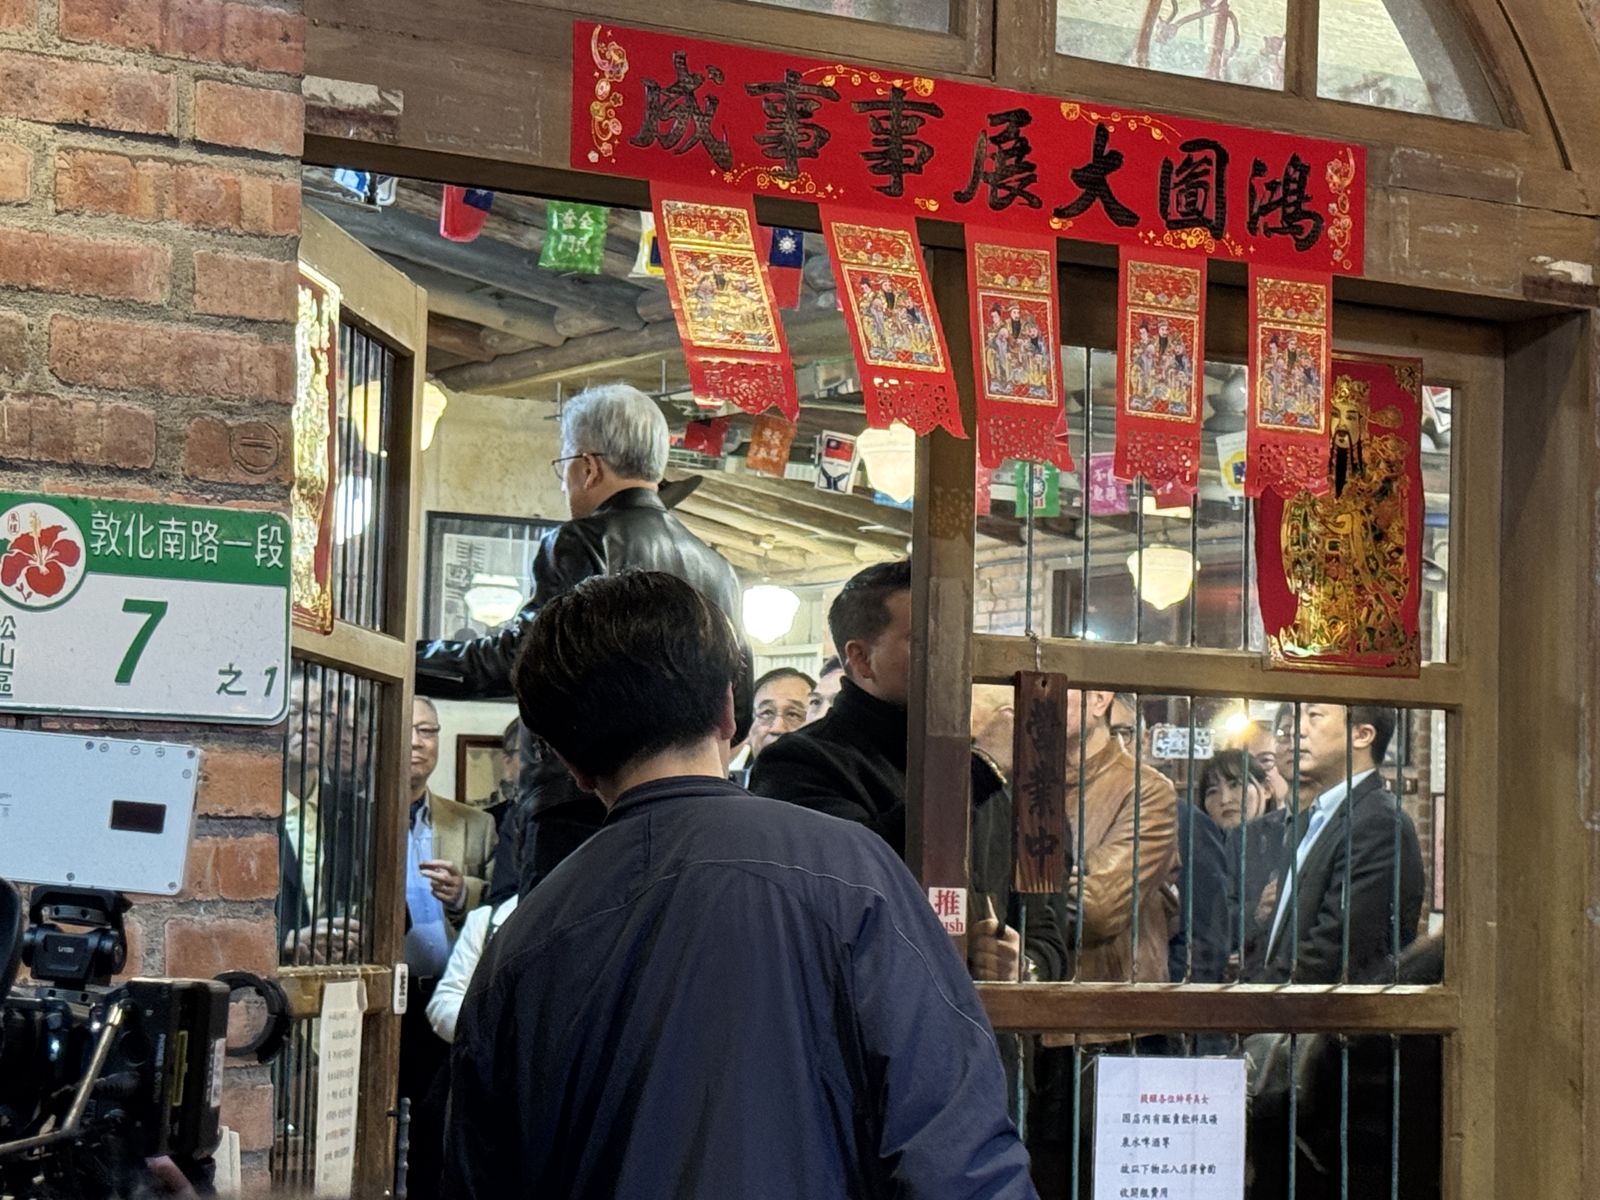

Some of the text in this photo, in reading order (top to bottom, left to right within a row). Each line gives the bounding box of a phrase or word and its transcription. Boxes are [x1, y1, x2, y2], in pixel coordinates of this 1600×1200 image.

[90, 511, 285, 569] 敦化南路一段
[114, 598, 169, 686] 7
[934, 889, 960, 917] 推
